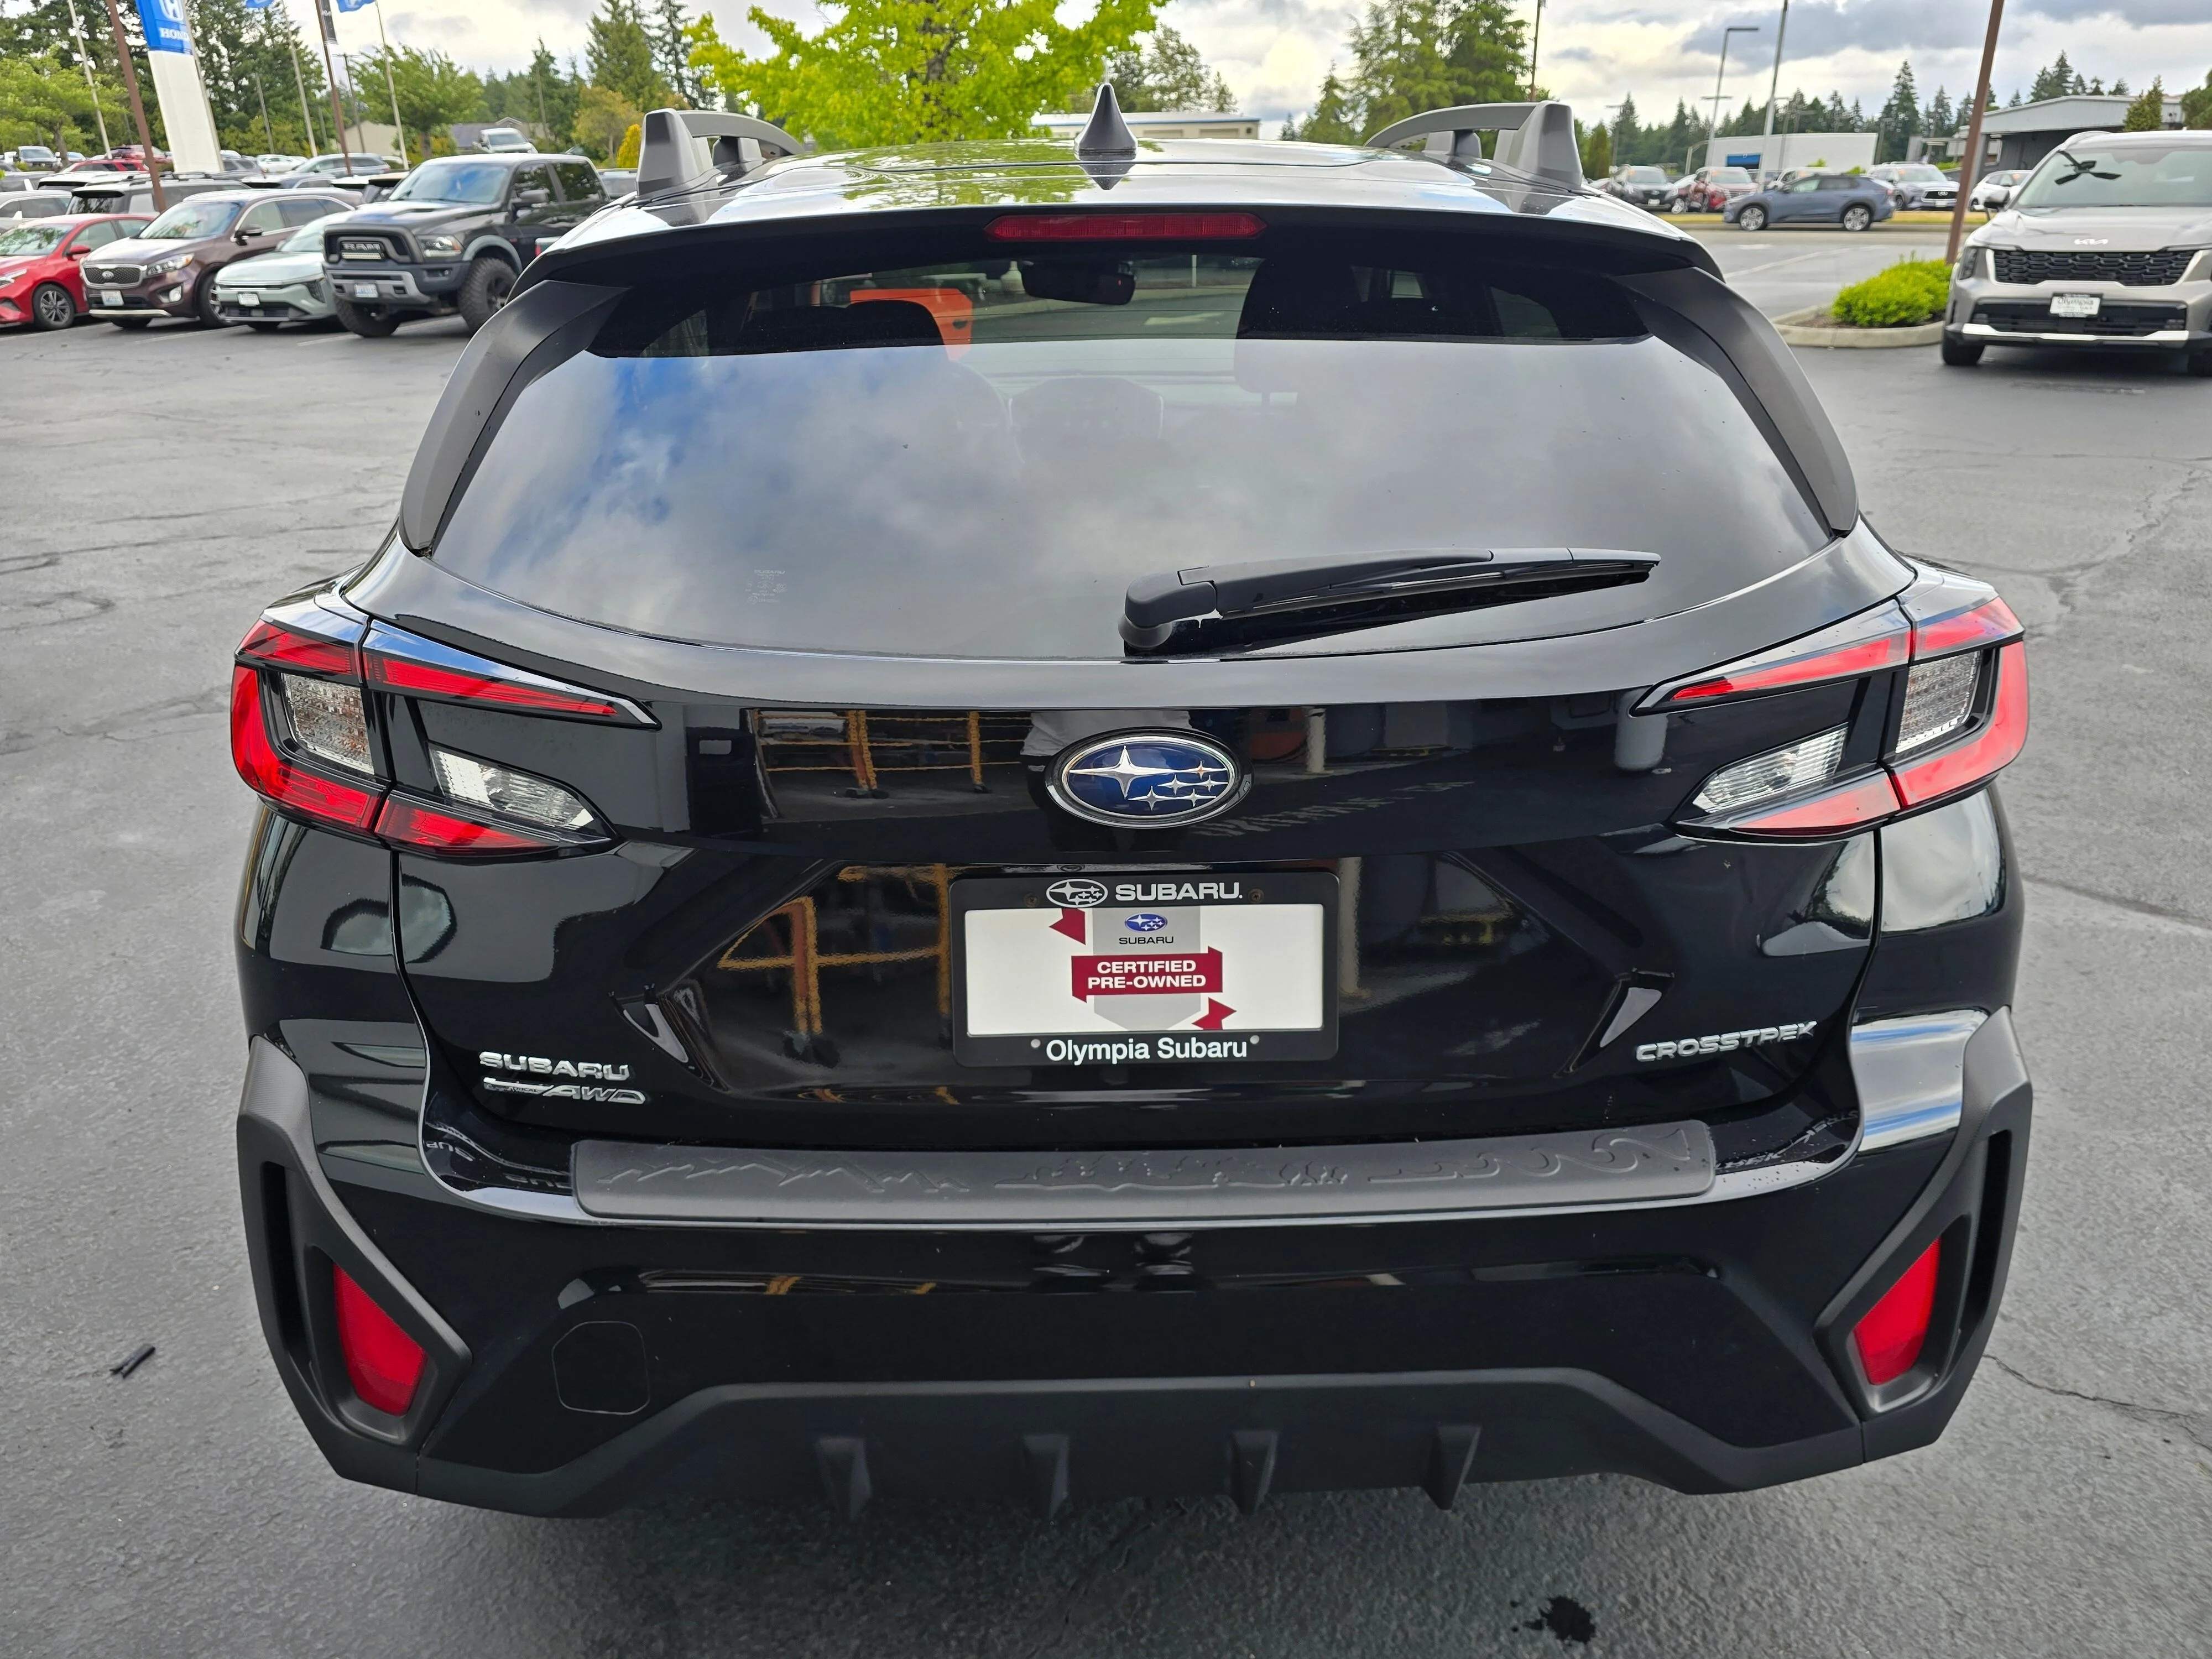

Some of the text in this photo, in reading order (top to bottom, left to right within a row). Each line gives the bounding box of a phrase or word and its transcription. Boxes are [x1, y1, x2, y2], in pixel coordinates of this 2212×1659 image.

[1119, 936, 1174, 945] SUBARU
[1097, 959, 1197, 974] CERTIFIED
[1088, 974, 1207, 989] PRE-OWNED
[1046, 1037, 1247, 1066] Olympia Subaru
[1636, 1020, 1818, 1062] CROSSTREK
[478, 1051, 630, 1081] SUBARU
[542, 1084, 646, 1105] AWD
